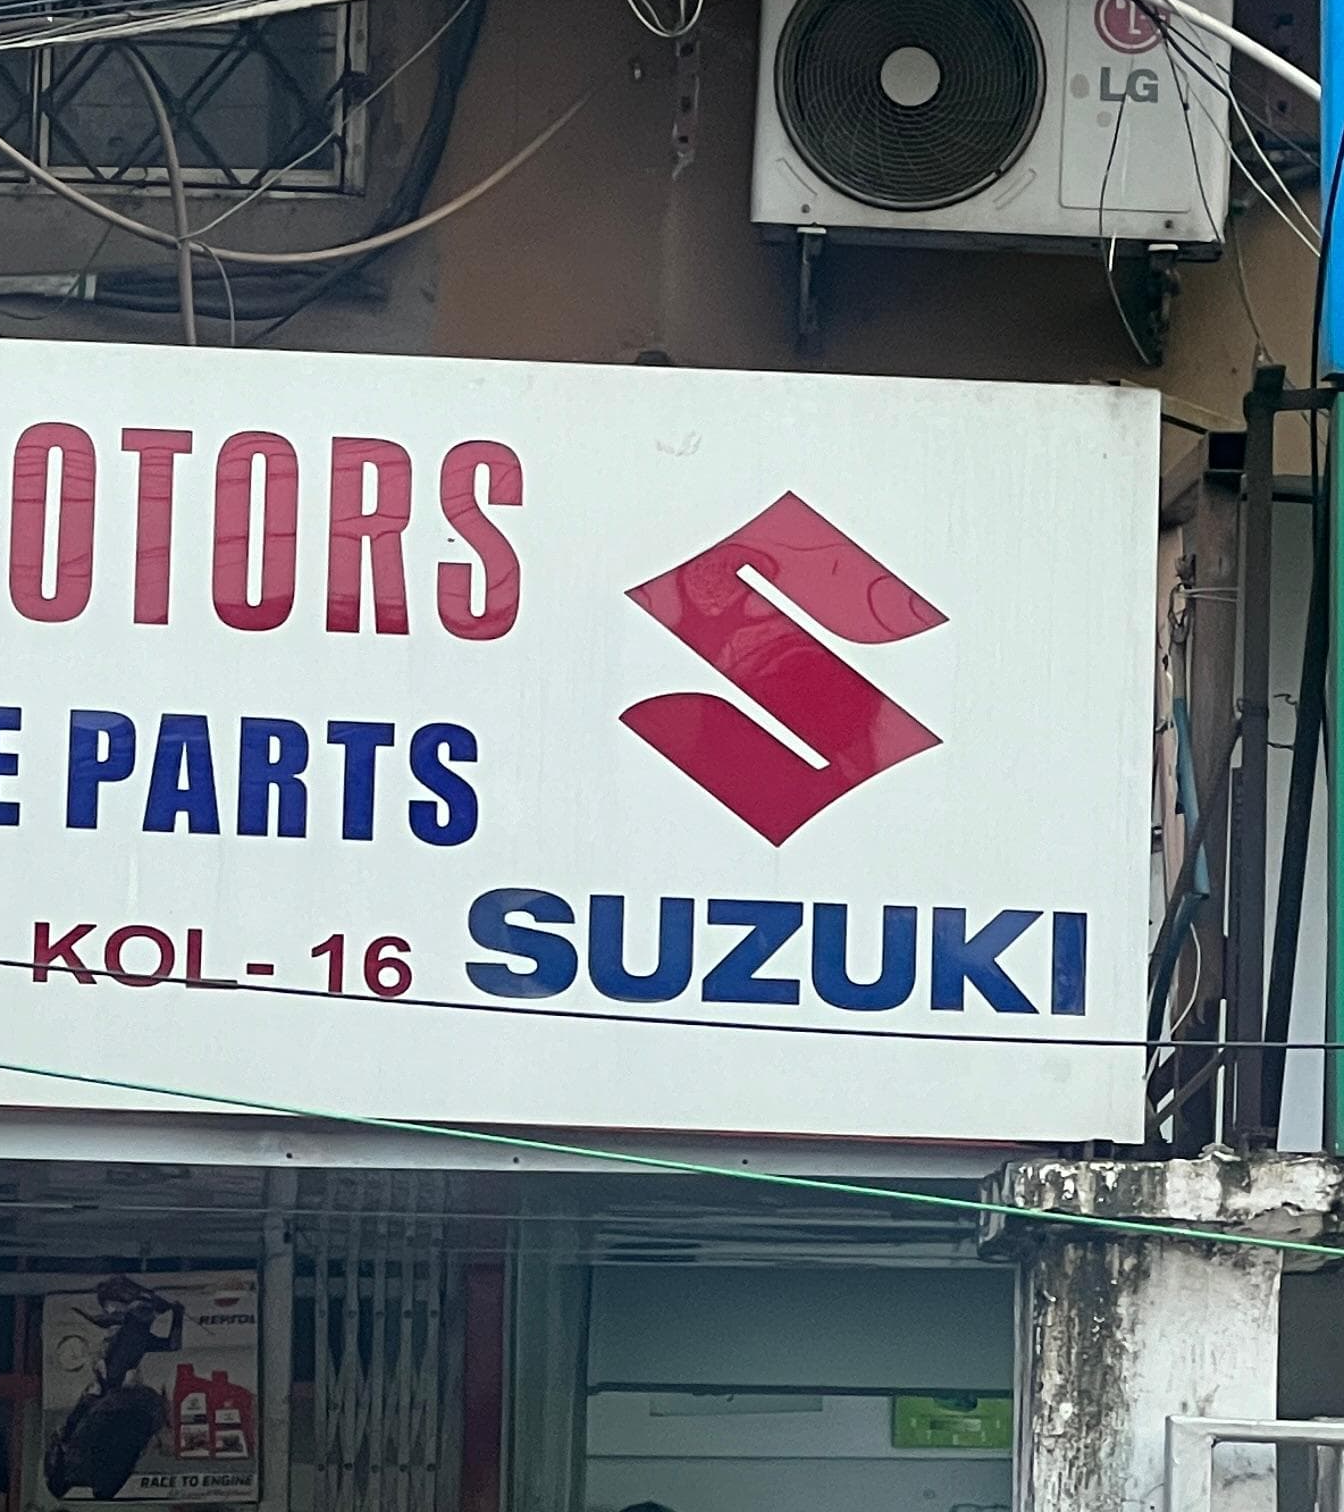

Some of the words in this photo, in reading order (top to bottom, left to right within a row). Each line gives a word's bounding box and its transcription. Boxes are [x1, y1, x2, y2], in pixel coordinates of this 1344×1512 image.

[1099, 66, 1159, 104] LG
[65, 709, 480, 847] PARTS
[311, 933, 414, 998] 16
[465, 887, 1088, 1016] SUZUKI
[181, 1475, 199, 1488] TO
